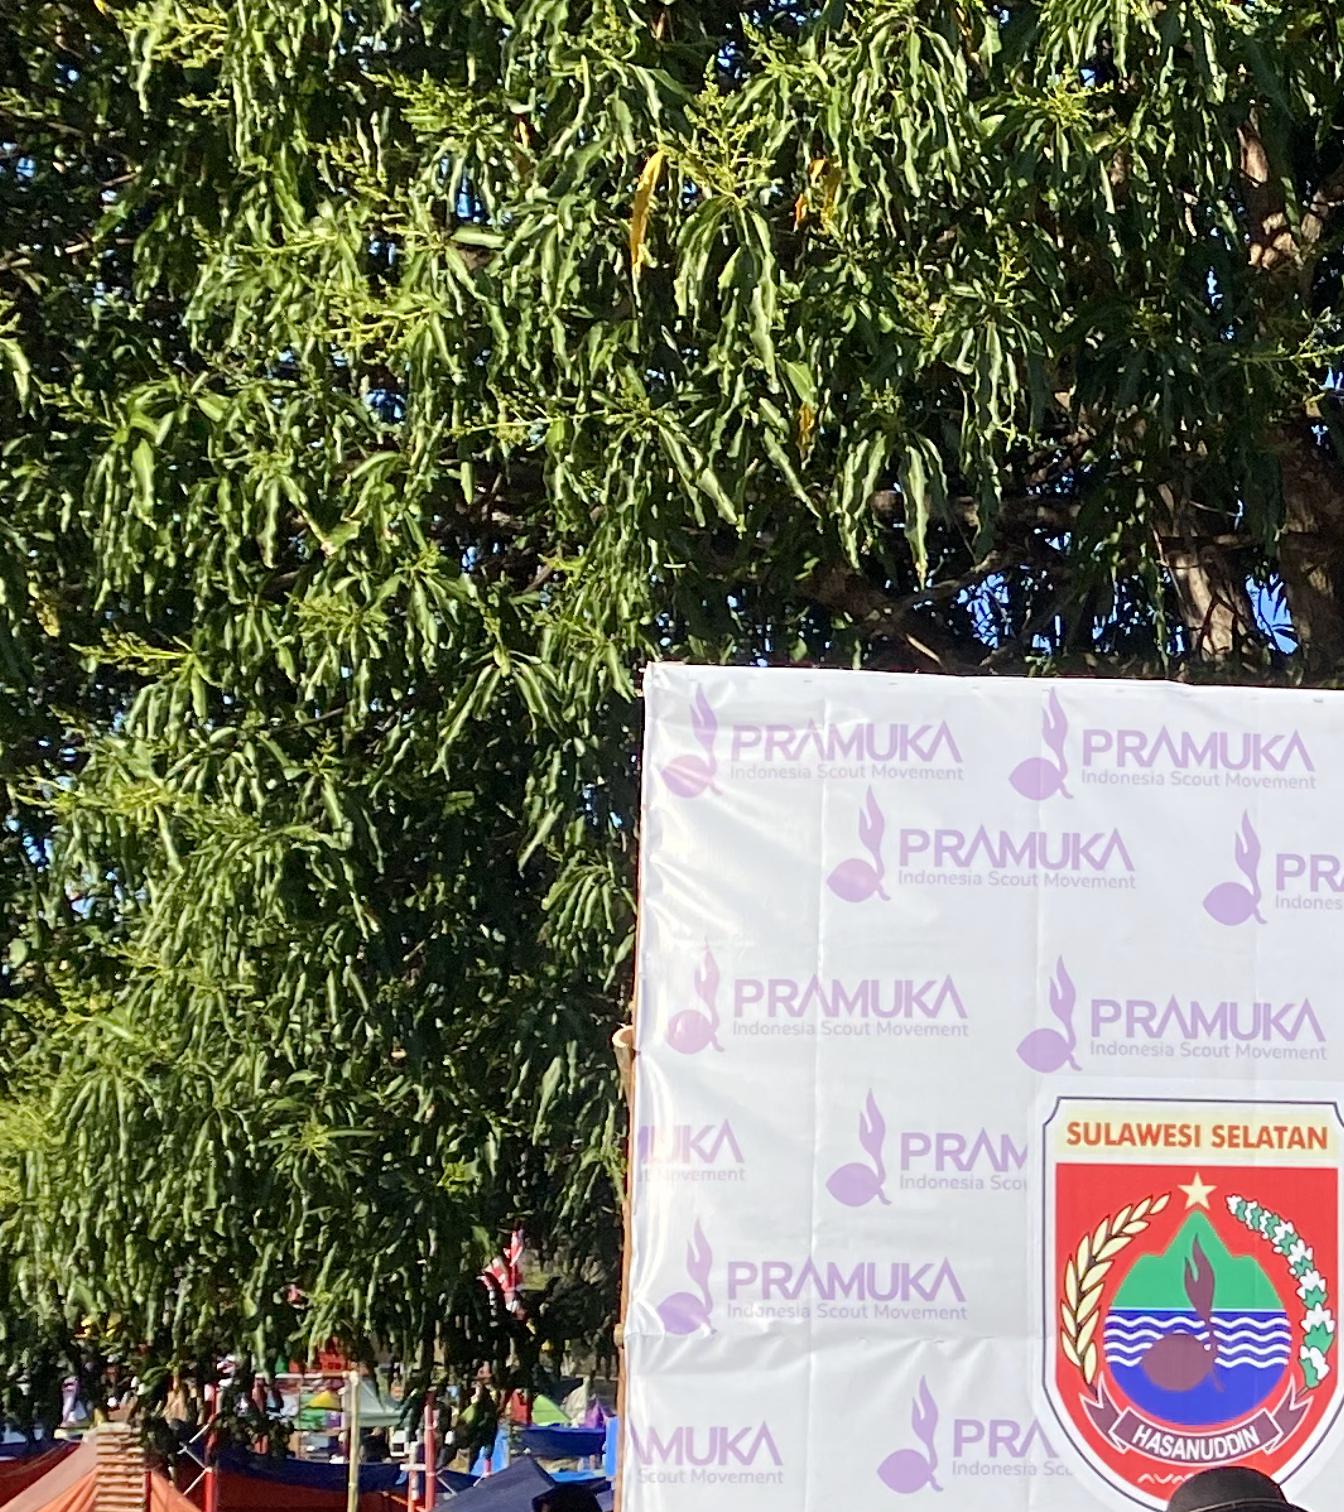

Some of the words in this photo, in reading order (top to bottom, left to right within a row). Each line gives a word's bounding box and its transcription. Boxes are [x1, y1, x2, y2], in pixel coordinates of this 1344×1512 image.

[730, 719, 963, 764] PRAMUKA
[1081, 727, 1315, 772] PRAMUKA
[730, 764, 812, 780] Indonesia
[814, 765, 866, 780] Scout
[869, 765, 964, 781] Movement
[1081, 771, 1165, 786] Indonesia
[1170, 772, 1222, 788] Scout
[1225, 773, 1316, 789] Movement
[898, 827, 1134, 872] PRAMUKA
[898, 872, 984, 887] Indonesia
[988, 873, 1040, 888] Scout
[1044, 874, 1135, 889] Movement
[732, 974, 968, 1020] PRAMUKA
[732, 1021, 817, 1036] Indonesia
[821, 1021, 874, 1037] Scout
[876, 1022, 968, 1037] Movement
[1089, 996, 1326, 1041] PRAMUKA
[1089, 1042, 1174, 1058] Indonesia
[1180, 1043, 1233, 1059] Scout
[1235, 1045, 1327, 1060] Movement
[1066, 1121, 1200, 1148] SULAWESI
[1211, 1124, 1328, 1149] SELATAN
[901, 1127, 1027, 1172] PRAM
[900, 1174, 984, 1190] Indonesia
[990, 1175, 1027, 1191] Sco
[727, 1256, 966, 1302] PRAMUKA
[727, 1303, 812, 1319] Indonesia
[816, 1304, 868, 1319] Scout
[872, 1304, 967, 1320] Movement
[1132, 1424, 1260, 1460] HASANUDDIN
[638, 1468, 685, 1484] Scout
[691, 1468, 783, 1484] Movement
[952, 1460, 1037, 1475] Indonesia
